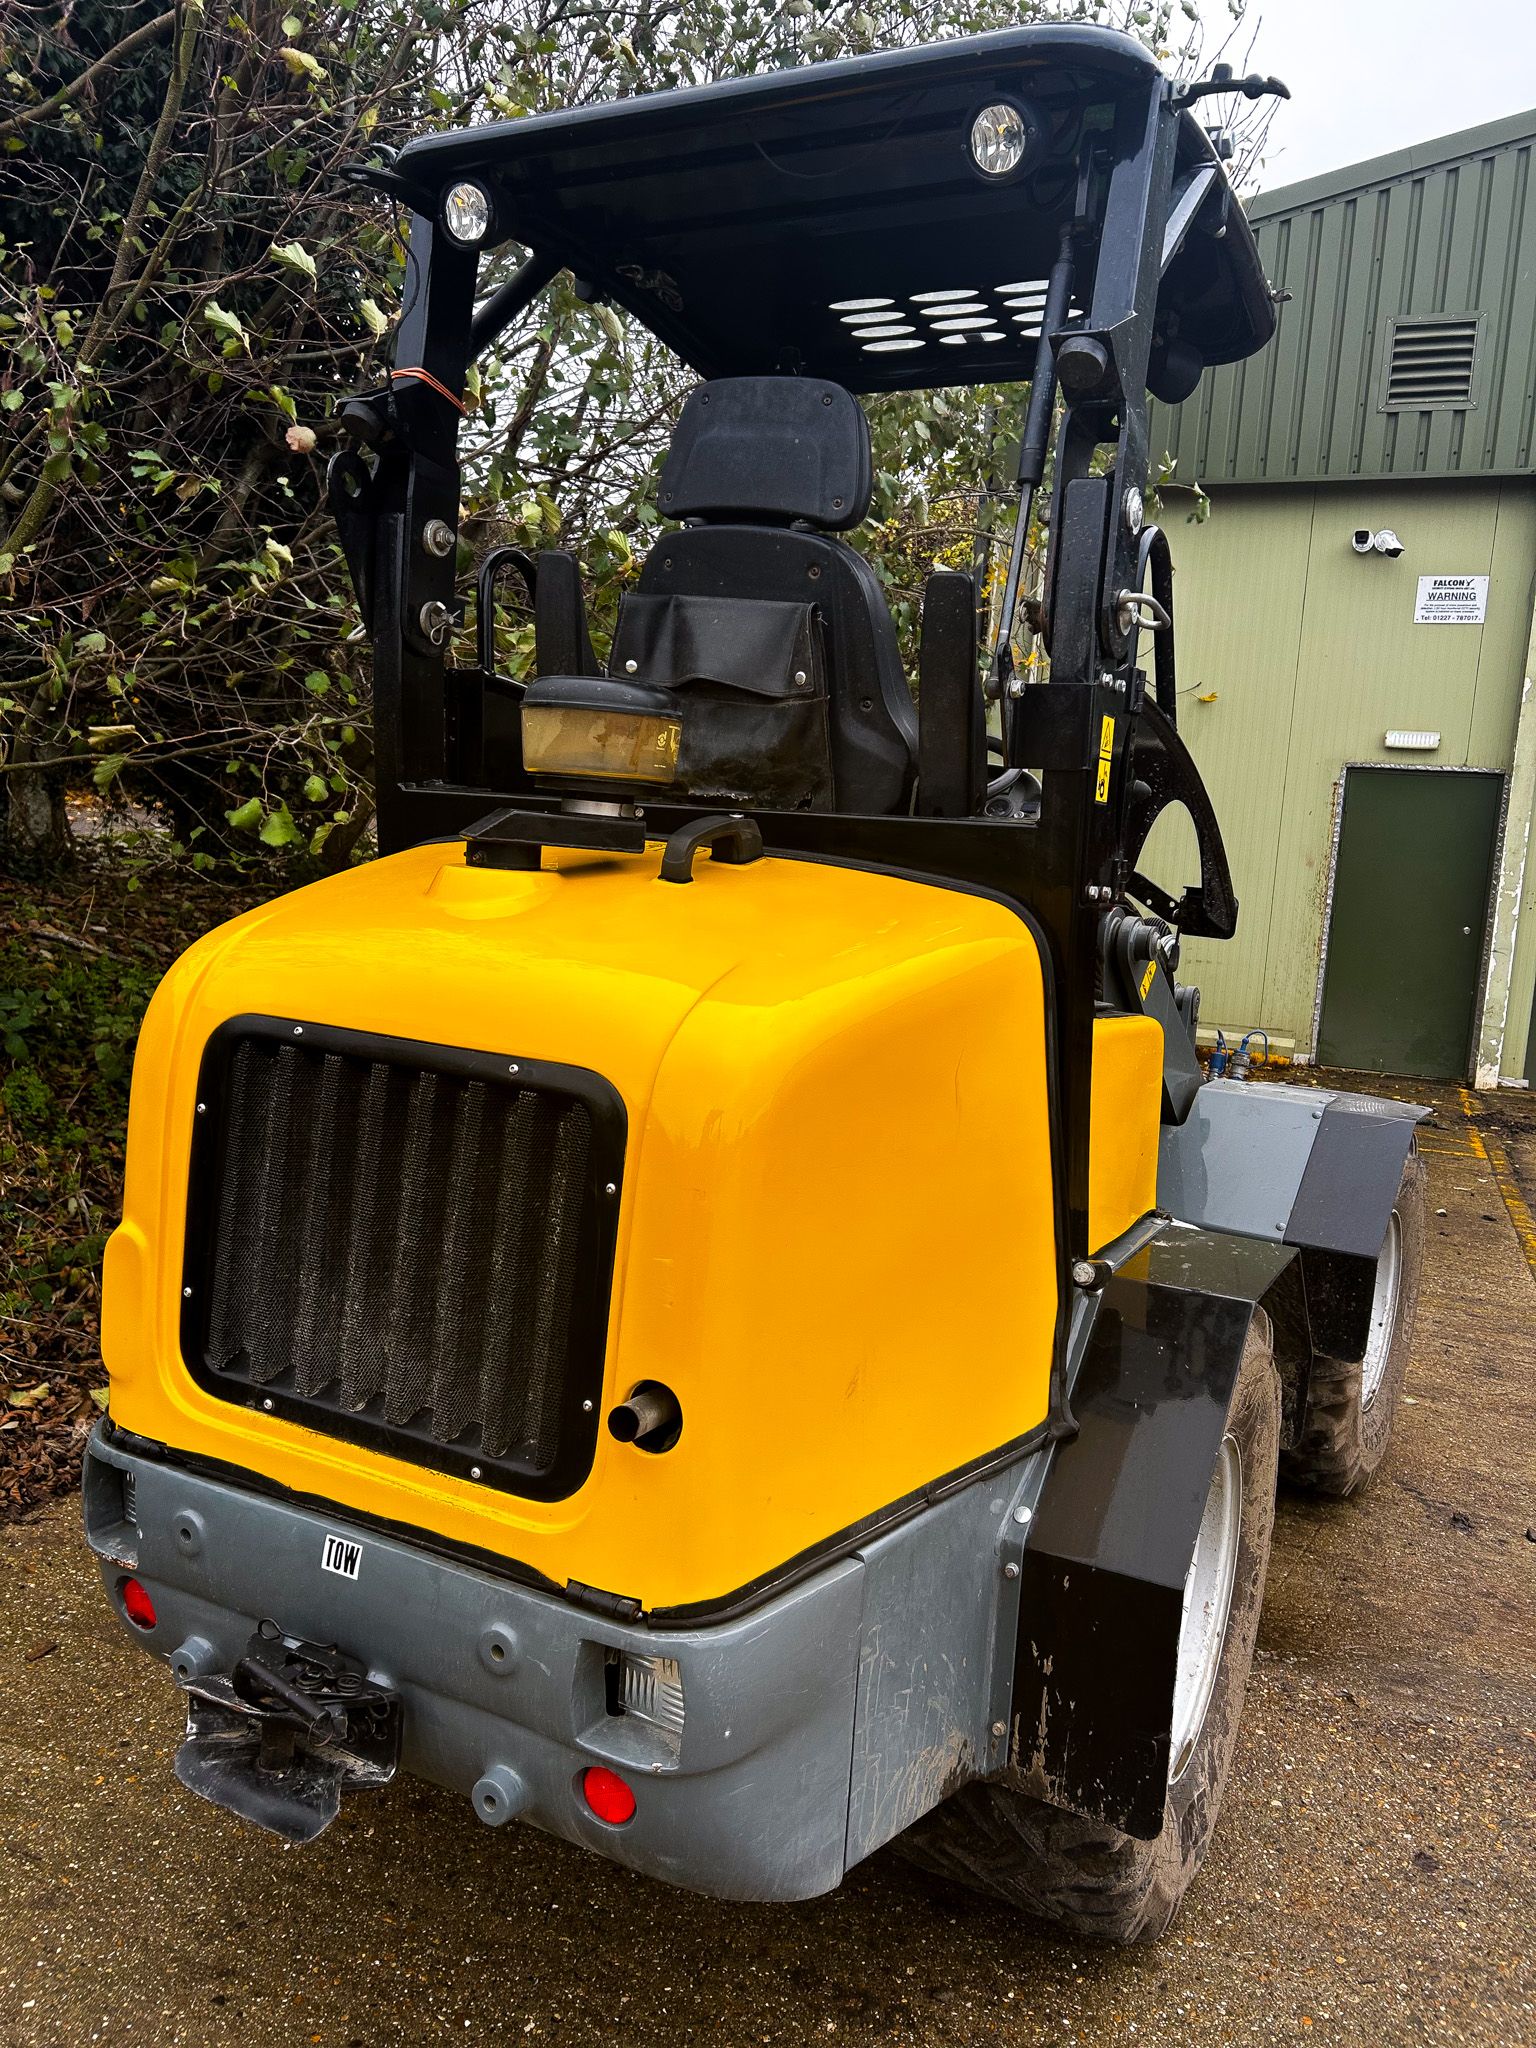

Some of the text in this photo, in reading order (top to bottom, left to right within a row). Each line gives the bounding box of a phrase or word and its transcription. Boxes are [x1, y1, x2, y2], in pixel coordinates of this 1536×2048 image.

[1433, 579, 1466, 587] FALCON
[1428, 592, 1477, 600] WARNING
[326, 1538, 361, 1576] TOW
